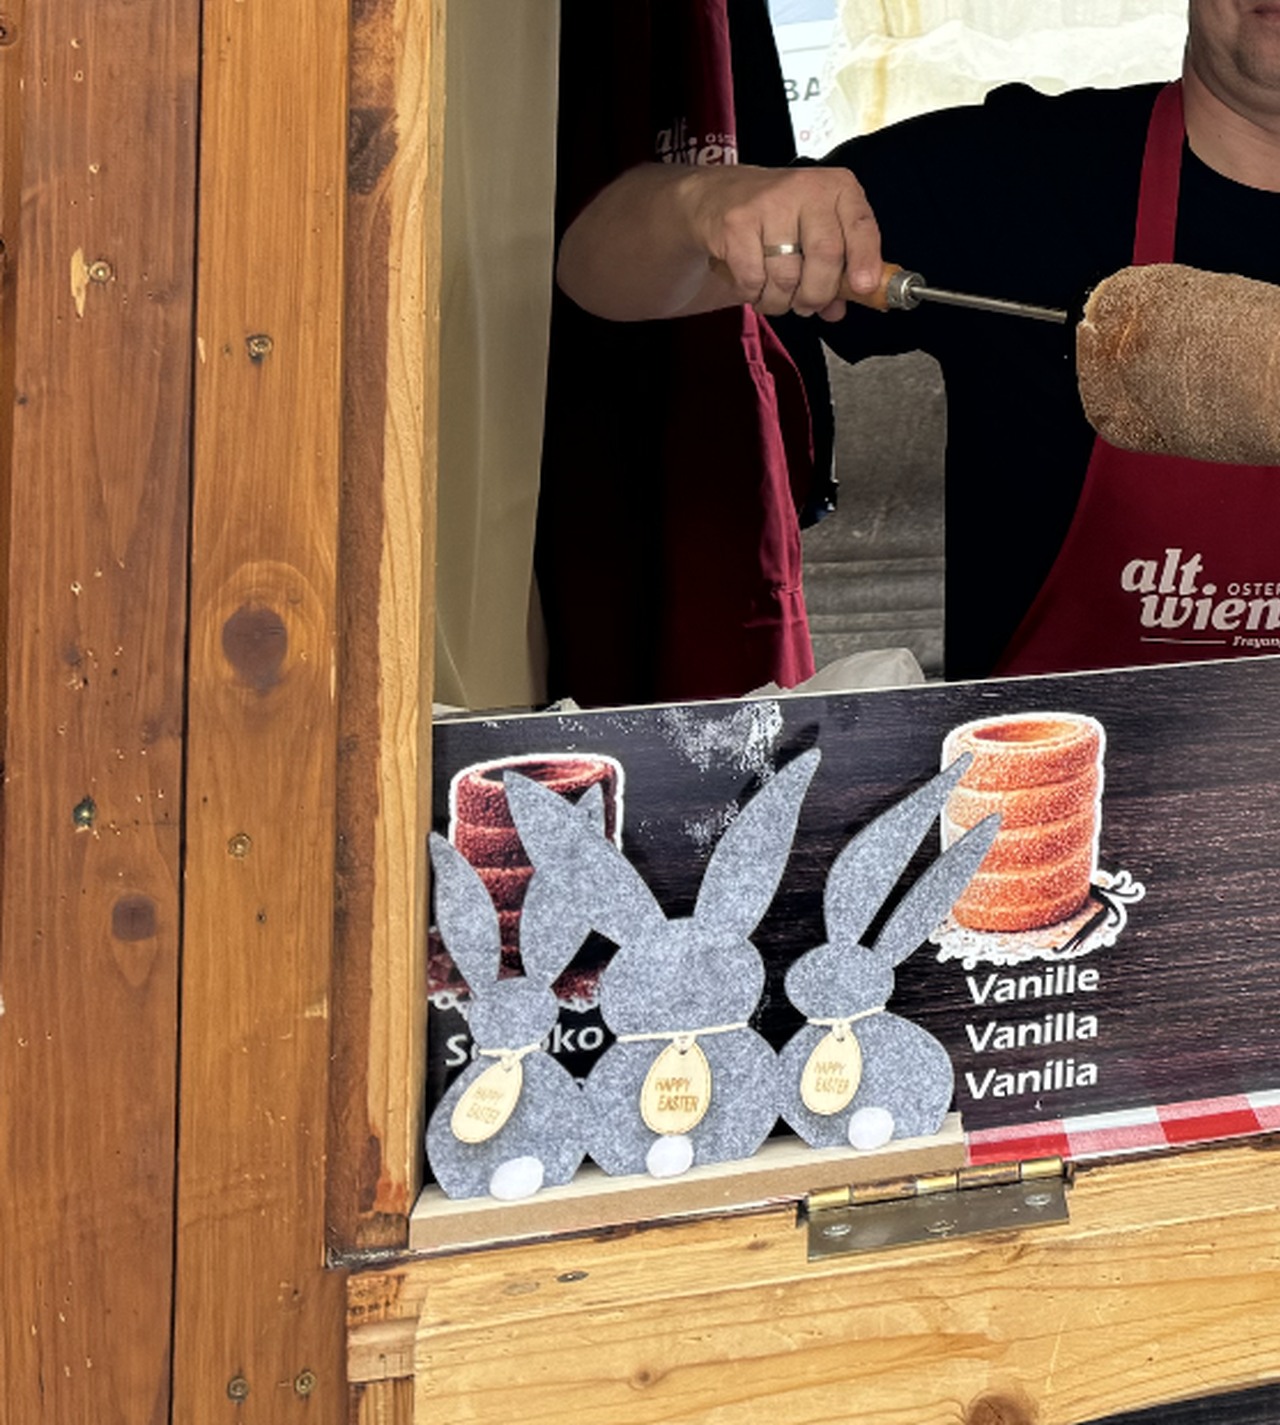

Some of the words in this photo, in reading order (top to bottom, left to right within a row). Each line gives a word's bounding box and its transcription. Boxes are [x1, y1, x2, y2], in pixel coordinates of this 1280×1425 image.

[966, 962, 1100, 1008] Vanille
[966, 1011, 1099, 1054] Vanilla
[655, 1077, 693, 1093] HAPPY
[658, 1095, 699, 1113] EASTER
